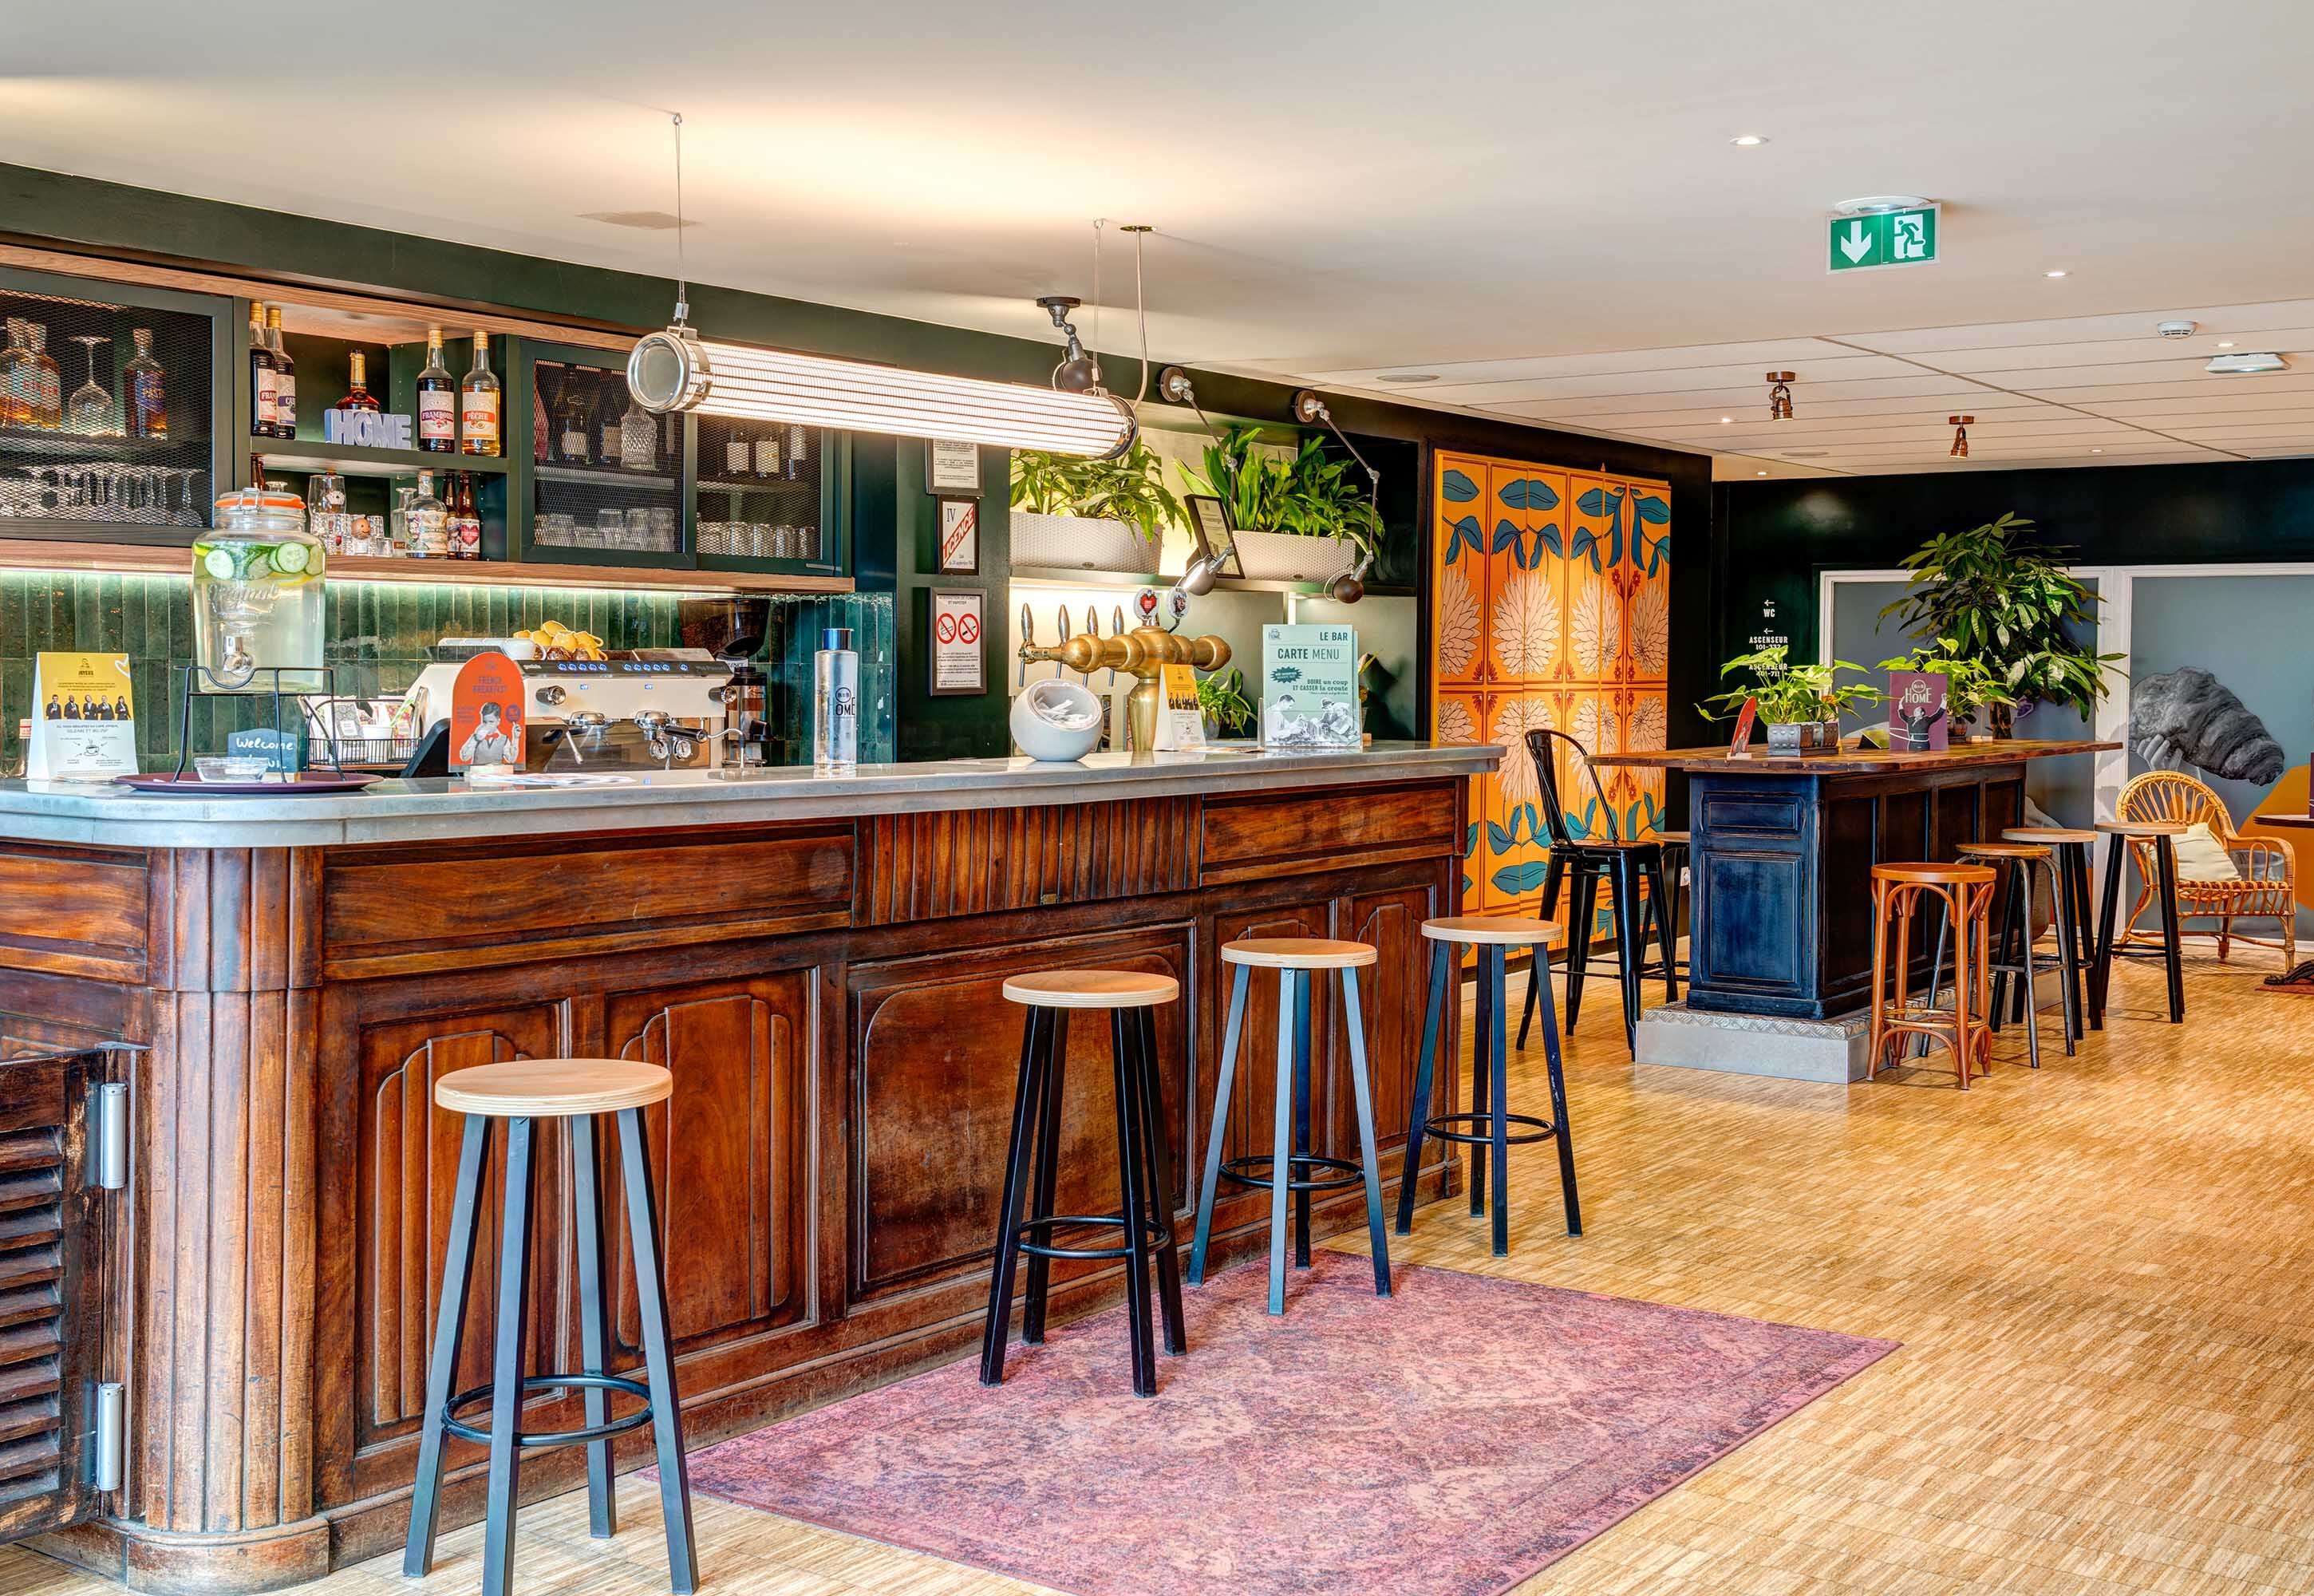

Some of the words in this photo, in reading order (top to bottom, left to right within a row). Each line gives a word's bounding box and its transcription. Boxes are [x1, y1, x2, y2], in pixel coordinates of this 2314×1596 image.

[330, 409, 411, 449] HOME
[946, 508, 956, 522] IV
[1763, 608, 1775, 618] WC
[1320, 632, 1328, 641] LE
[1332, 632, 1348, 641] BAR
[1277, 648, 1309, 659] CARTE
[1313, 648, 1340, 659] MENU
[1905, 687, 1932, 703] HOME
[235, 737, 294, 751] Welcome
